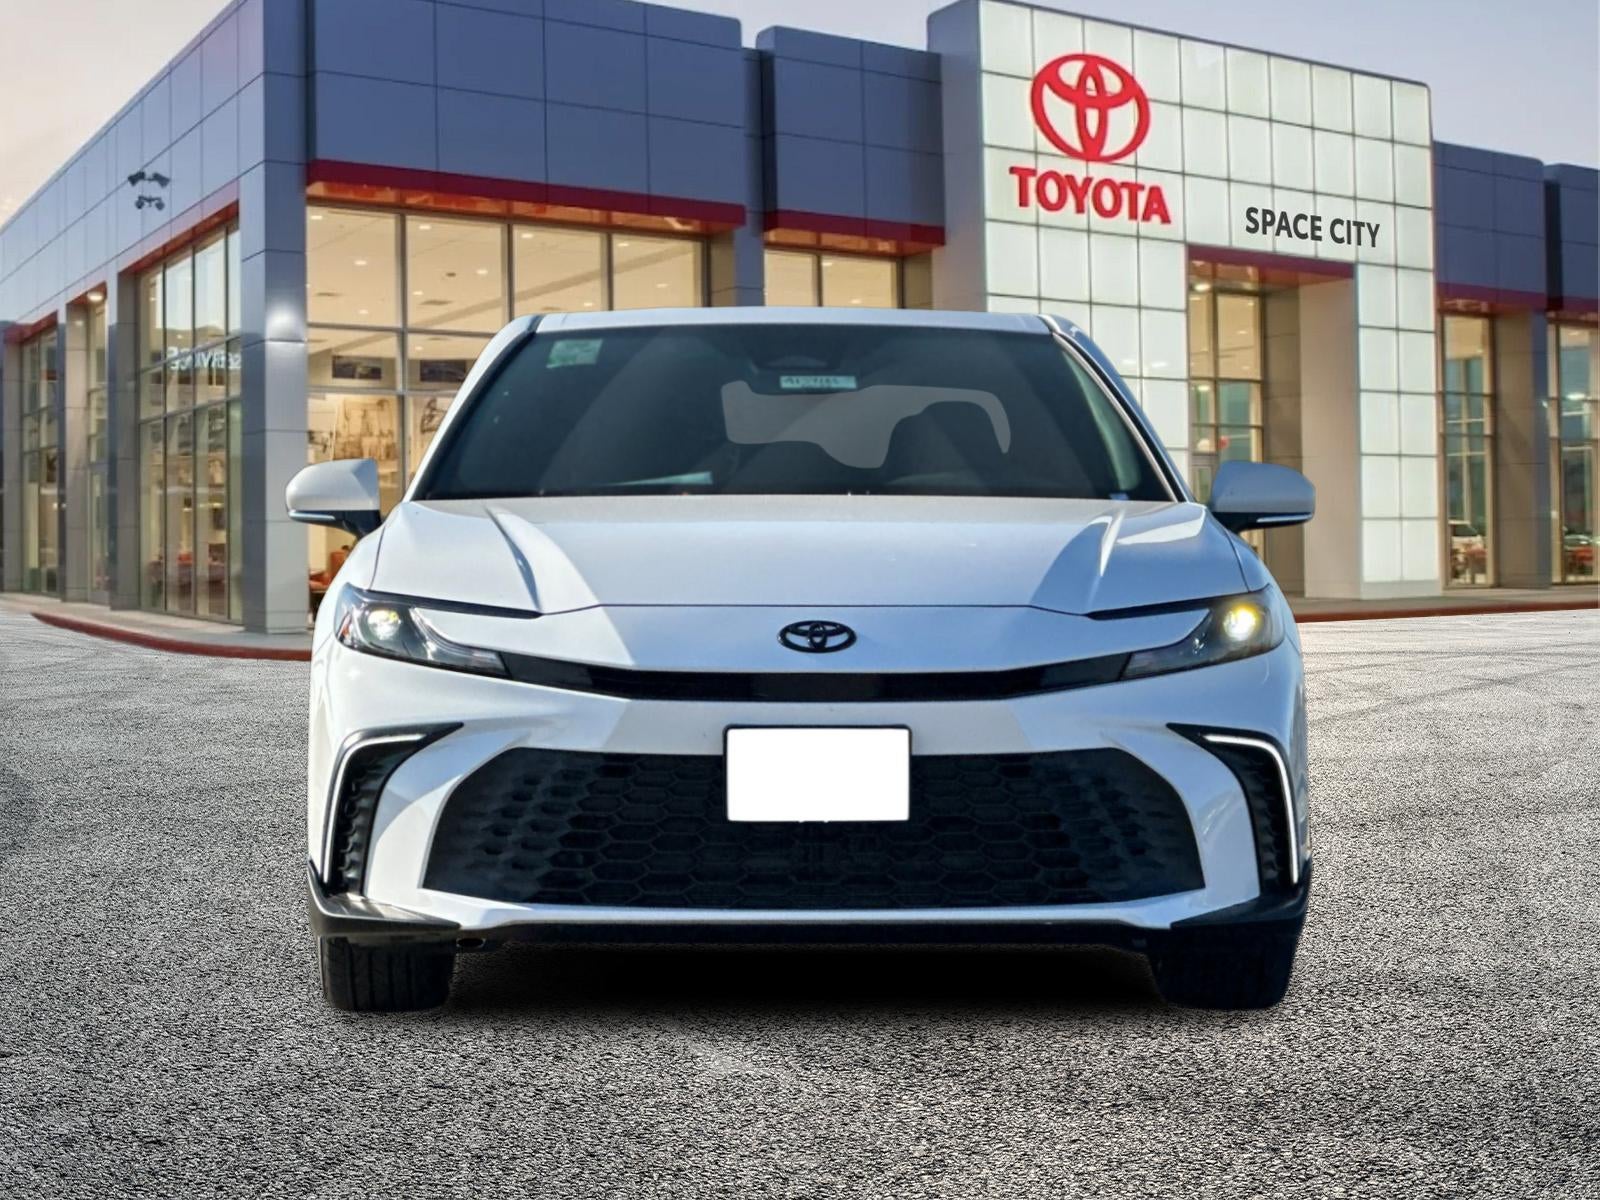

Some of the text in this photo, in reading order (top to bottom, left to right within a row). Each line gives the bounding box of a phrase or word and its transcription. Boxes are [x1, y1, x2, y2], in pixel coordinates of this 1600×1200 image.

[1009, 166, 1171, 224] TOYOTA
[1245, 206, 1380, 248] SPACE CITY
